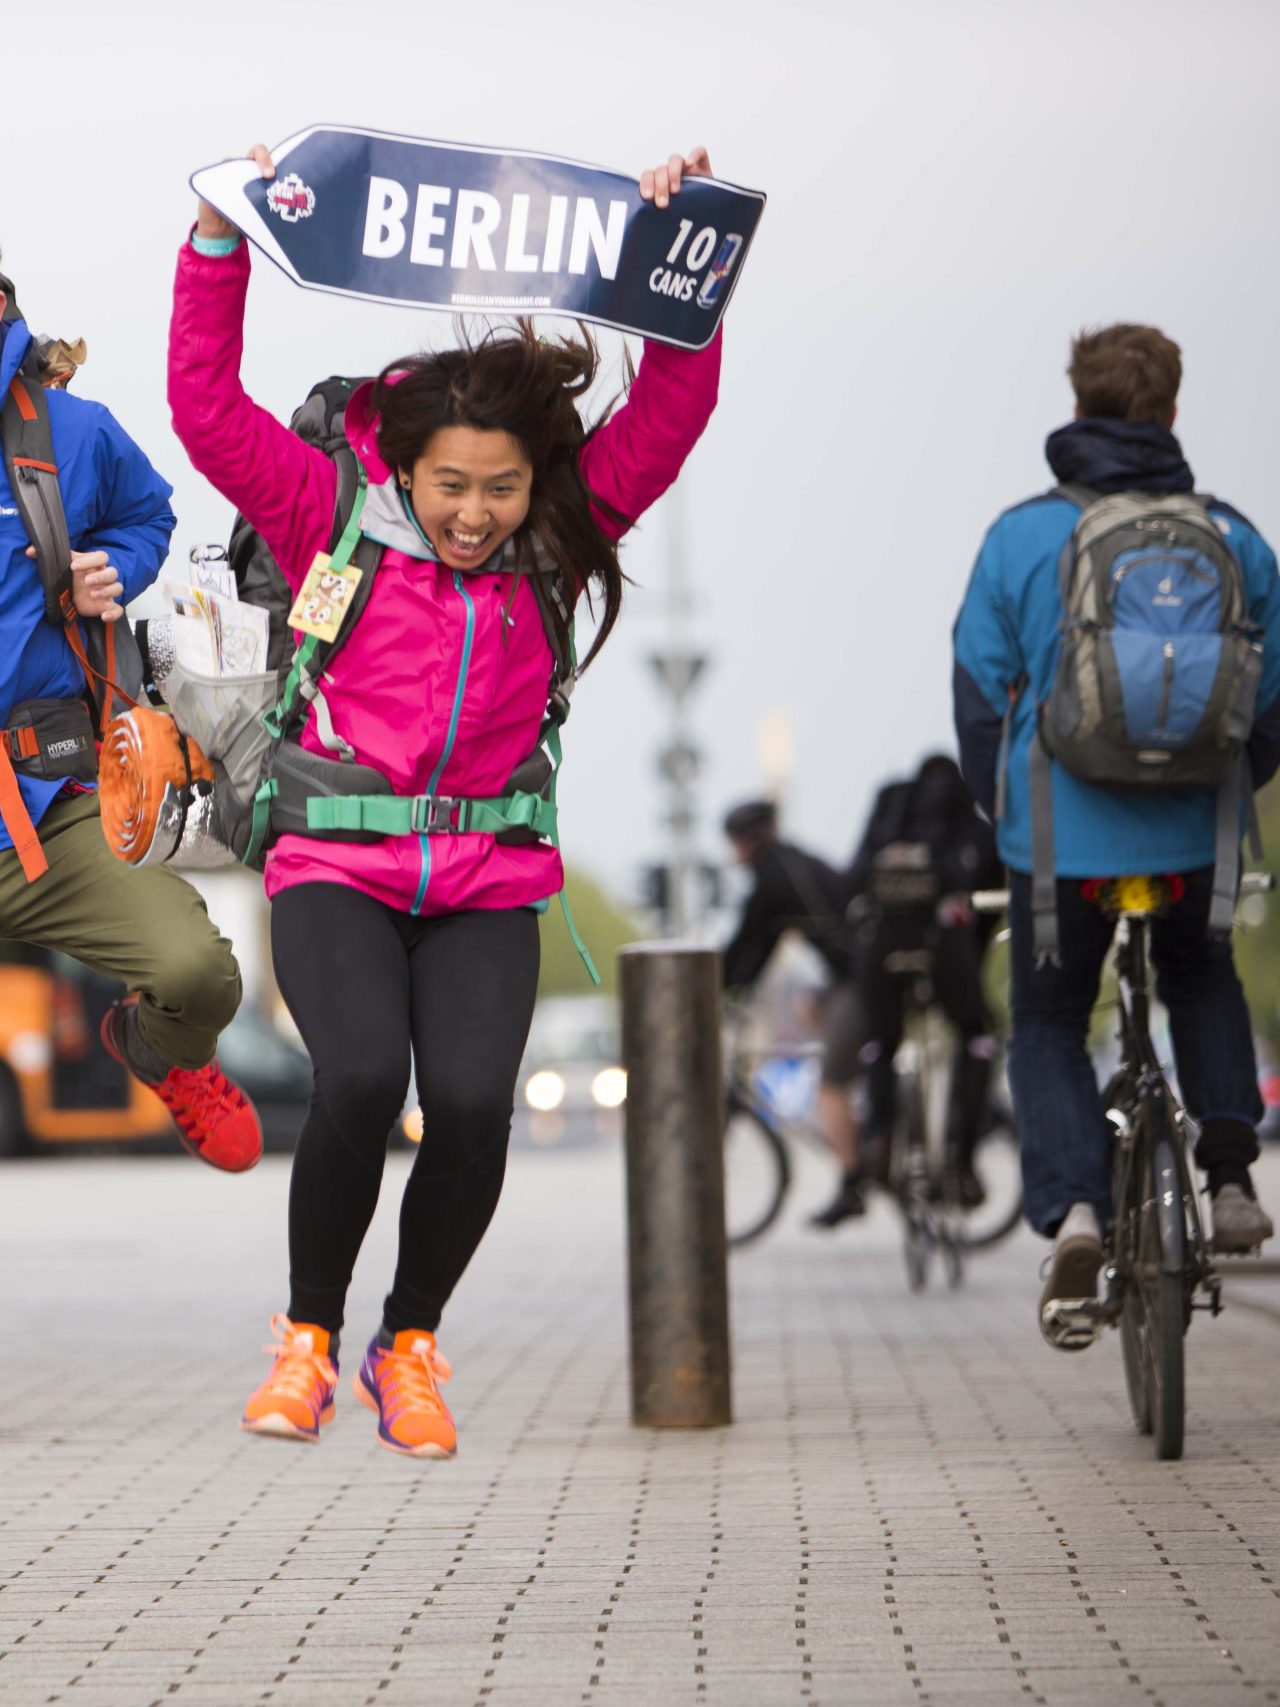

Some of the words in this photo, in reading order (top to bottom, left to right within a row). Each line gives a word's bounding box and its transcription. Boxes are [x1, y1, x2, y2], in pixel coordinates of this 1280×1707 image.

[362, 177, 627, 280] BERLIN
[666, 218, 717, 272] 10
[649, 267, 697, 301] CANS
